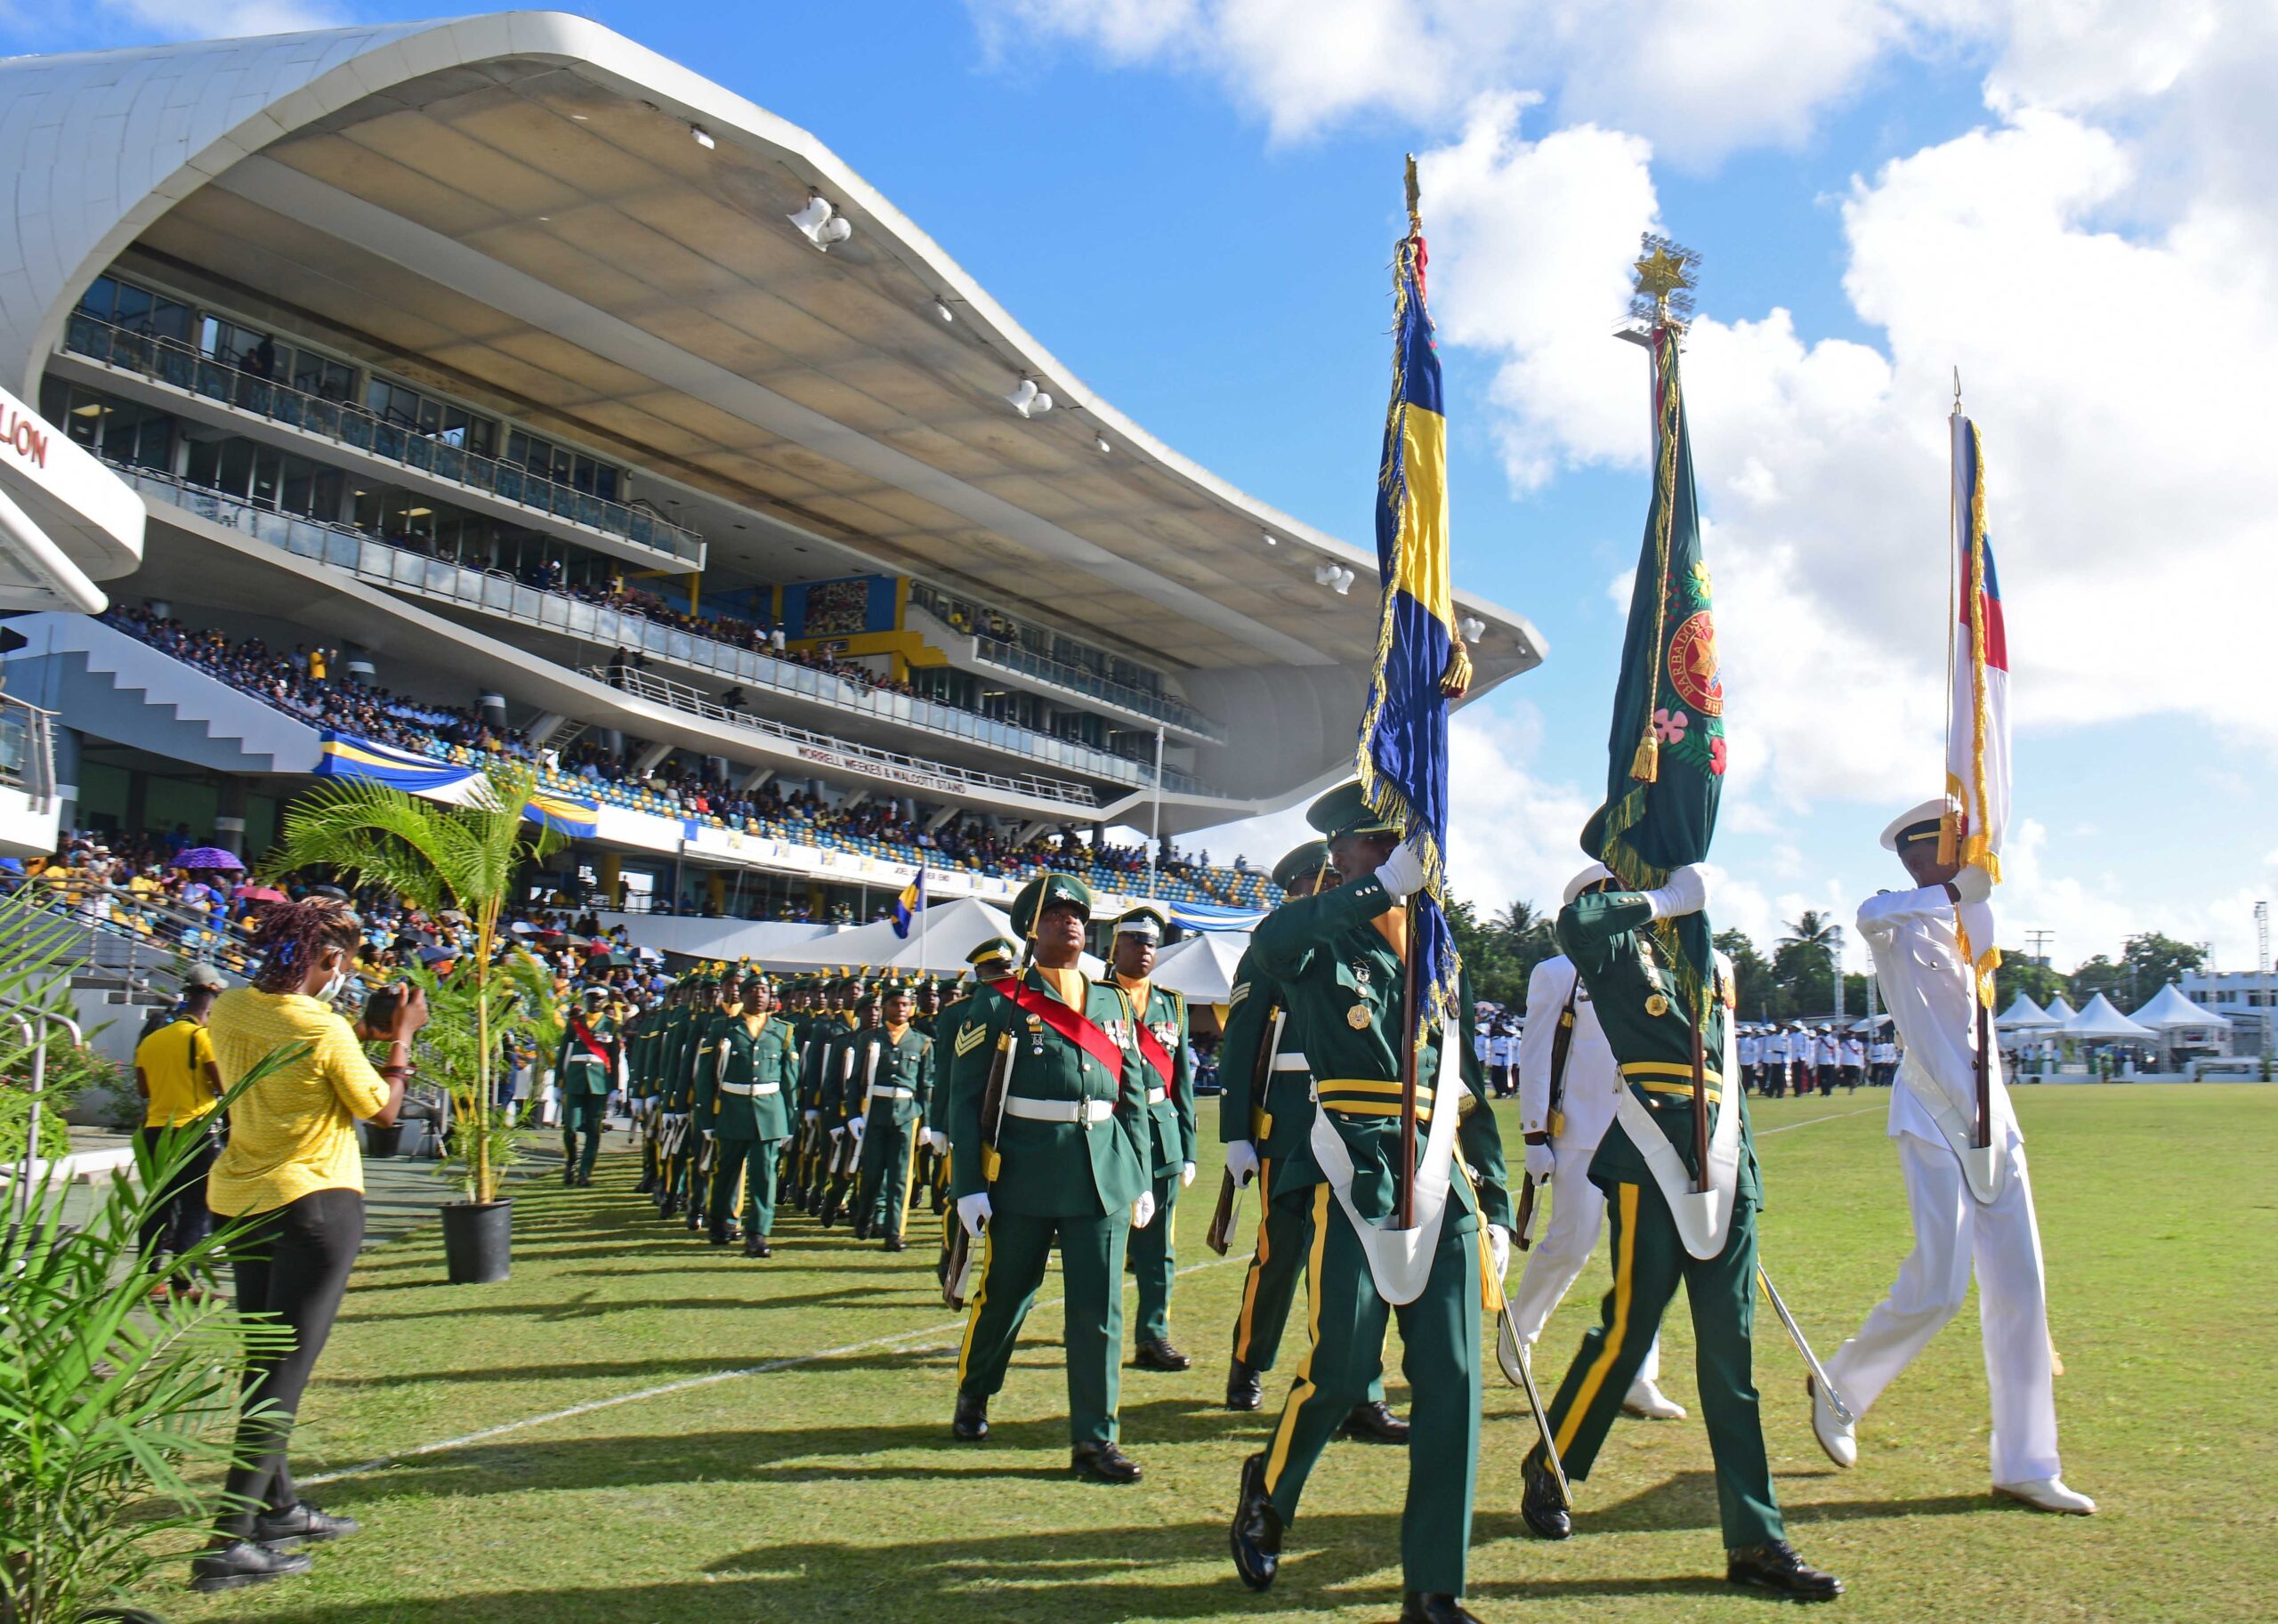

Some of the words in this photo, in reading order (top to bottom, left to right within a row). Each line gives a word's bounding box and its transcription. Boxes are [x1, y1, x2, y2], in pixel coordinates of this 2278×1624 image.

[1671, 618, 1700, 698] BARBADOS
[797, 746, 843, 767] WORRELL
[845, 758, 882, 775] WEEKES
[893, 769, 934, 788] WALCOTT
[935, 779, 966, 794] STAND
